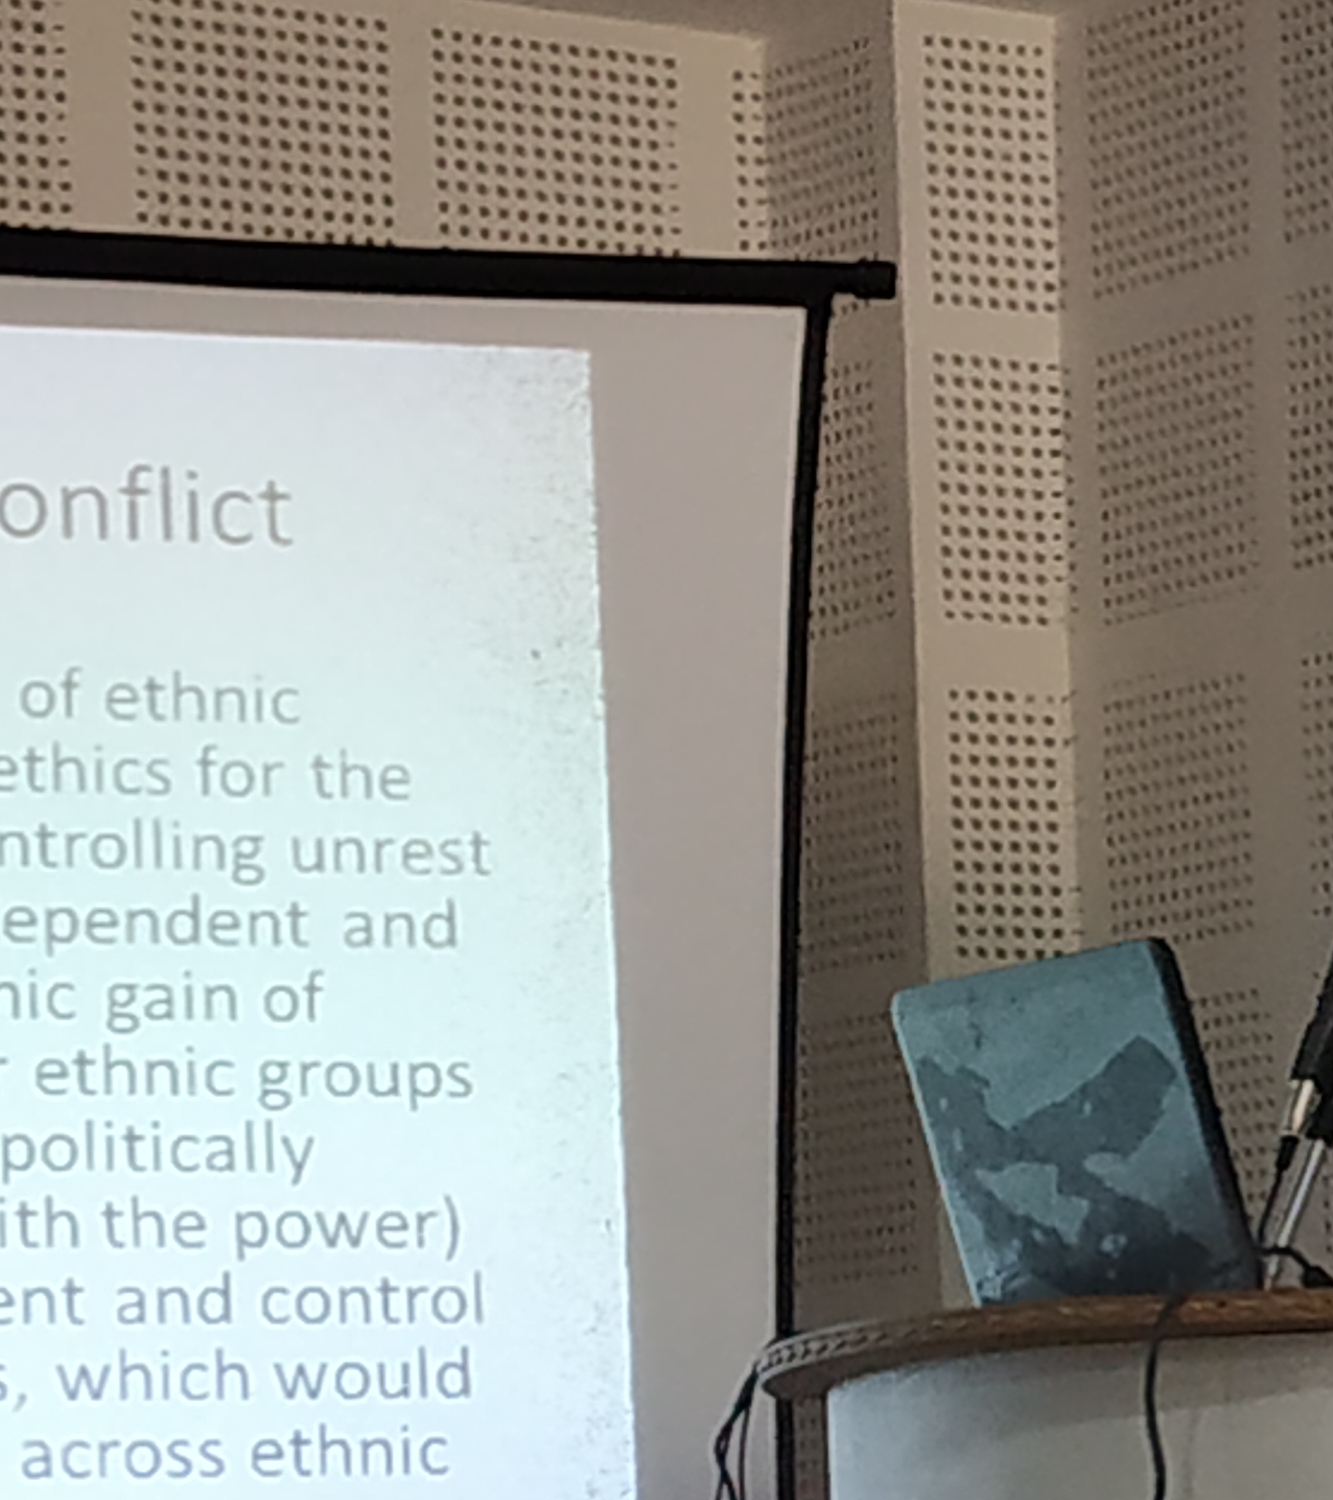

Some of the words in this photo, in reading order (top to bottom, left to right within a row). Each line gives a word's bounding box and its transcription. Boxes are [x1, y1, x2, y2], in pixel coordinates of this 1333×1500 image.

[0, 465, 293, 546] onflict
[20, 667, 81, 718] of
[106, 670, 300, 724] ethnic
[196, 745, 284, 797] for
[311, 748, 410, 800] the
[0, 818, 265, 885] ntrolling
[292, 831, 491, 876] unrest
[3, 893, 309, 957] ependent
[344, 898, 458, 949] and
[107, 971, 237, 1034] gain
[264, 969, 324, 1022] of
[36, 1043, 235, 1096] ethnic
[258, 1060, 472, 1112] groups
[2, 1120, 314, 1185] politically
[0, 1195, 79, 1248] ith
[101, 1195, 206, 1249] the
[235, 1195, 460, 1261] power)
[117, 1271, 232, 1324] and
[262, 1270, 483, 1324] control
[56, 1348, 249, 1401] which
[273, 1345, 471, 1400] would
[22, 1439, 225, 1479] across
[251, 1423, 449, 1477] ethnic
